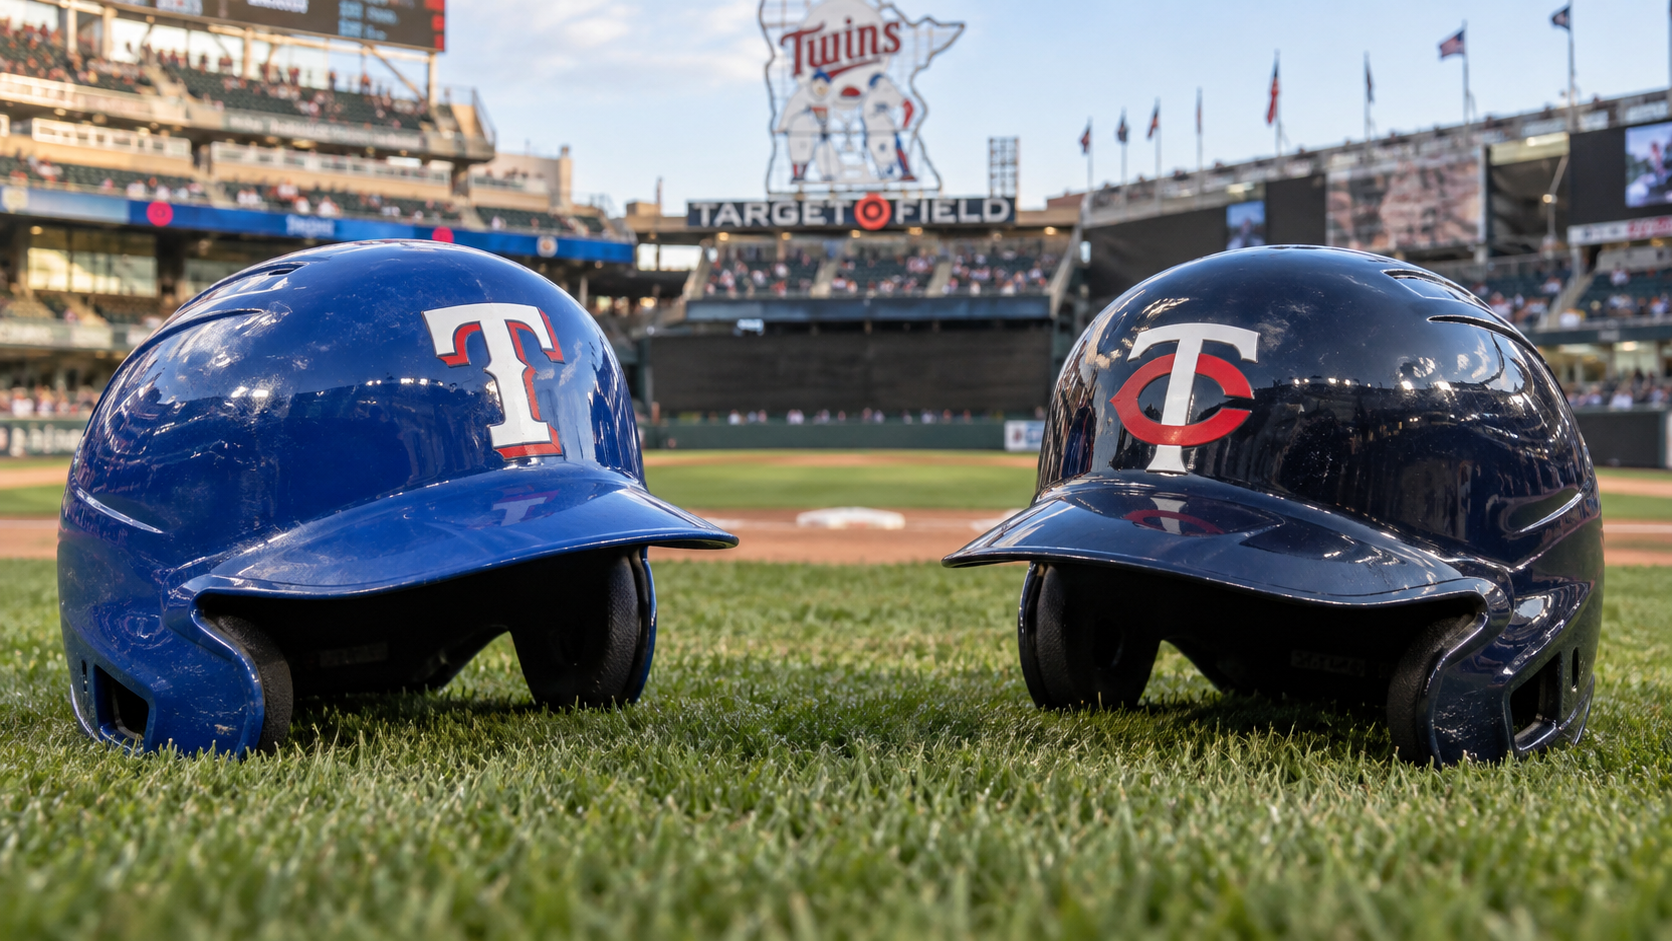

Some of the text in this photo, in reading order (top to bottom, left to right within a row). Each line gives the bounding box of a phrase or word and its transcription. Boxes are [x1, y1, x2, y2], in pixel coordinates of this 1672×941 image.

[780, 18, 901, 77] Twins
[693, 199, 1011, 227] TARGET FIELD
[421, 303, 565, 461] T
